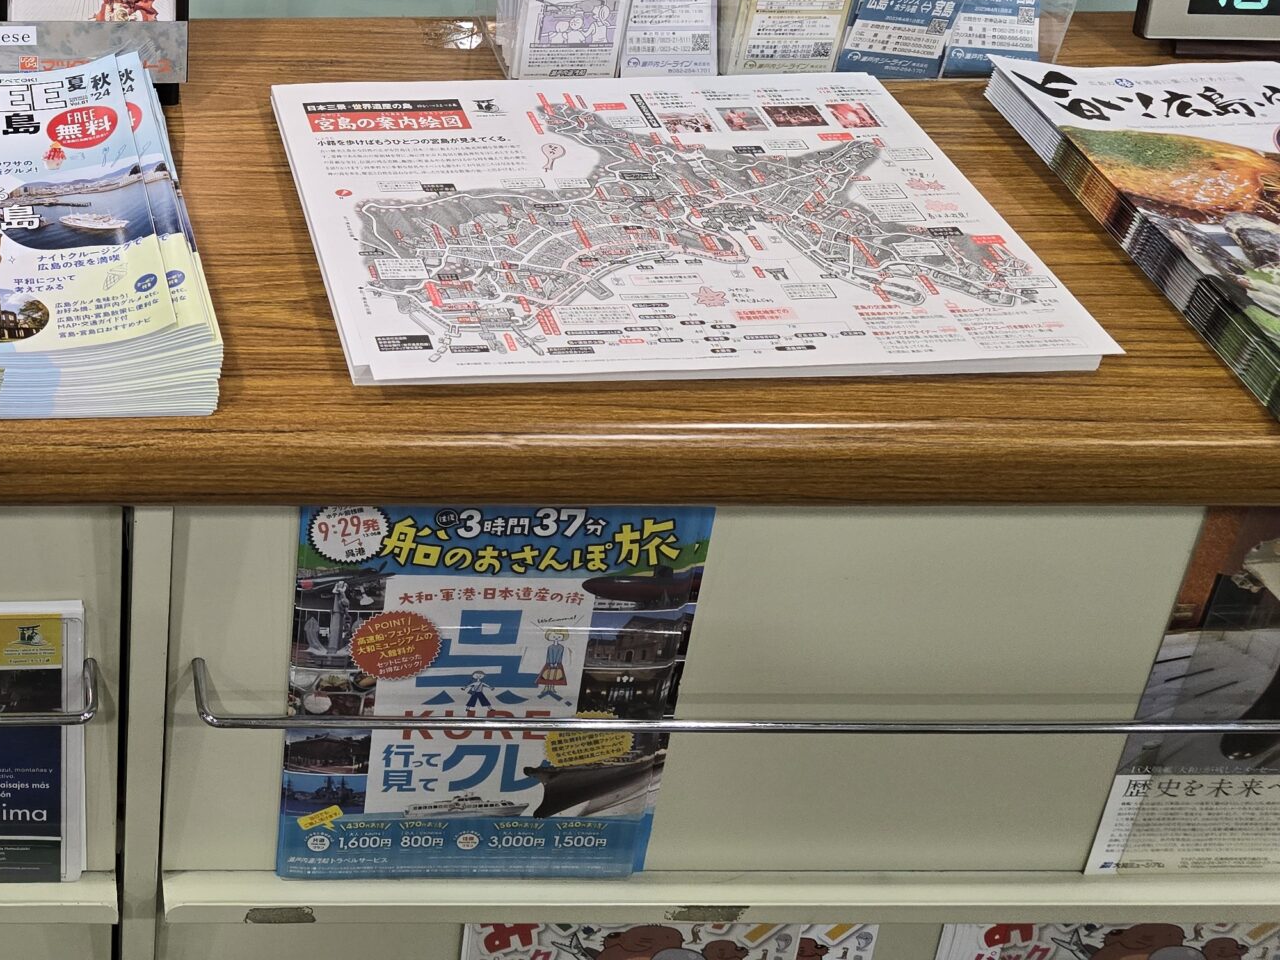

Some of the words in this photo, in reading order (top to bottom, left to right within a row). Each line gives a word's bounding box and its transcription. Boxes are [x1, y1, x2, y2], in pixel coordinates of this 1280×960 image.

[931, 0, 956, 18] 宮島
[67, 108, 96, 123] FREE
[314, 116, 464, 131] 宮島の案内絵図
[55, 116, 112, 141] 無料
[37, 236, 143, 262] ナイトクルージングで
[37, 254, 121, 272] 広島の夜を満喫
[14, 274, 76, 285] 平和について
[15, 284, 65, 293] 考えてみる
[318, 515, 380, 541] 9:29発
[457, 508, 607, 540] 3時間37分
[381, 515, 682, 575] 船のおさんぽ旅
[374, 618, 406, 630] POINT
[402, 710, 553, 741] KURE
[382, 743, 442, 768] 行って
[442, 744, 552, 792] クレ
[31, 781, 50, 789] más
[381, 770, 436, 793] 見て
[338, 836, 392, 849] 1,600円
[400, 836, 444, 848] 800円
[488, 835, 545, 849] 3,000円
[554, 835, 607, 849] 1,500円
